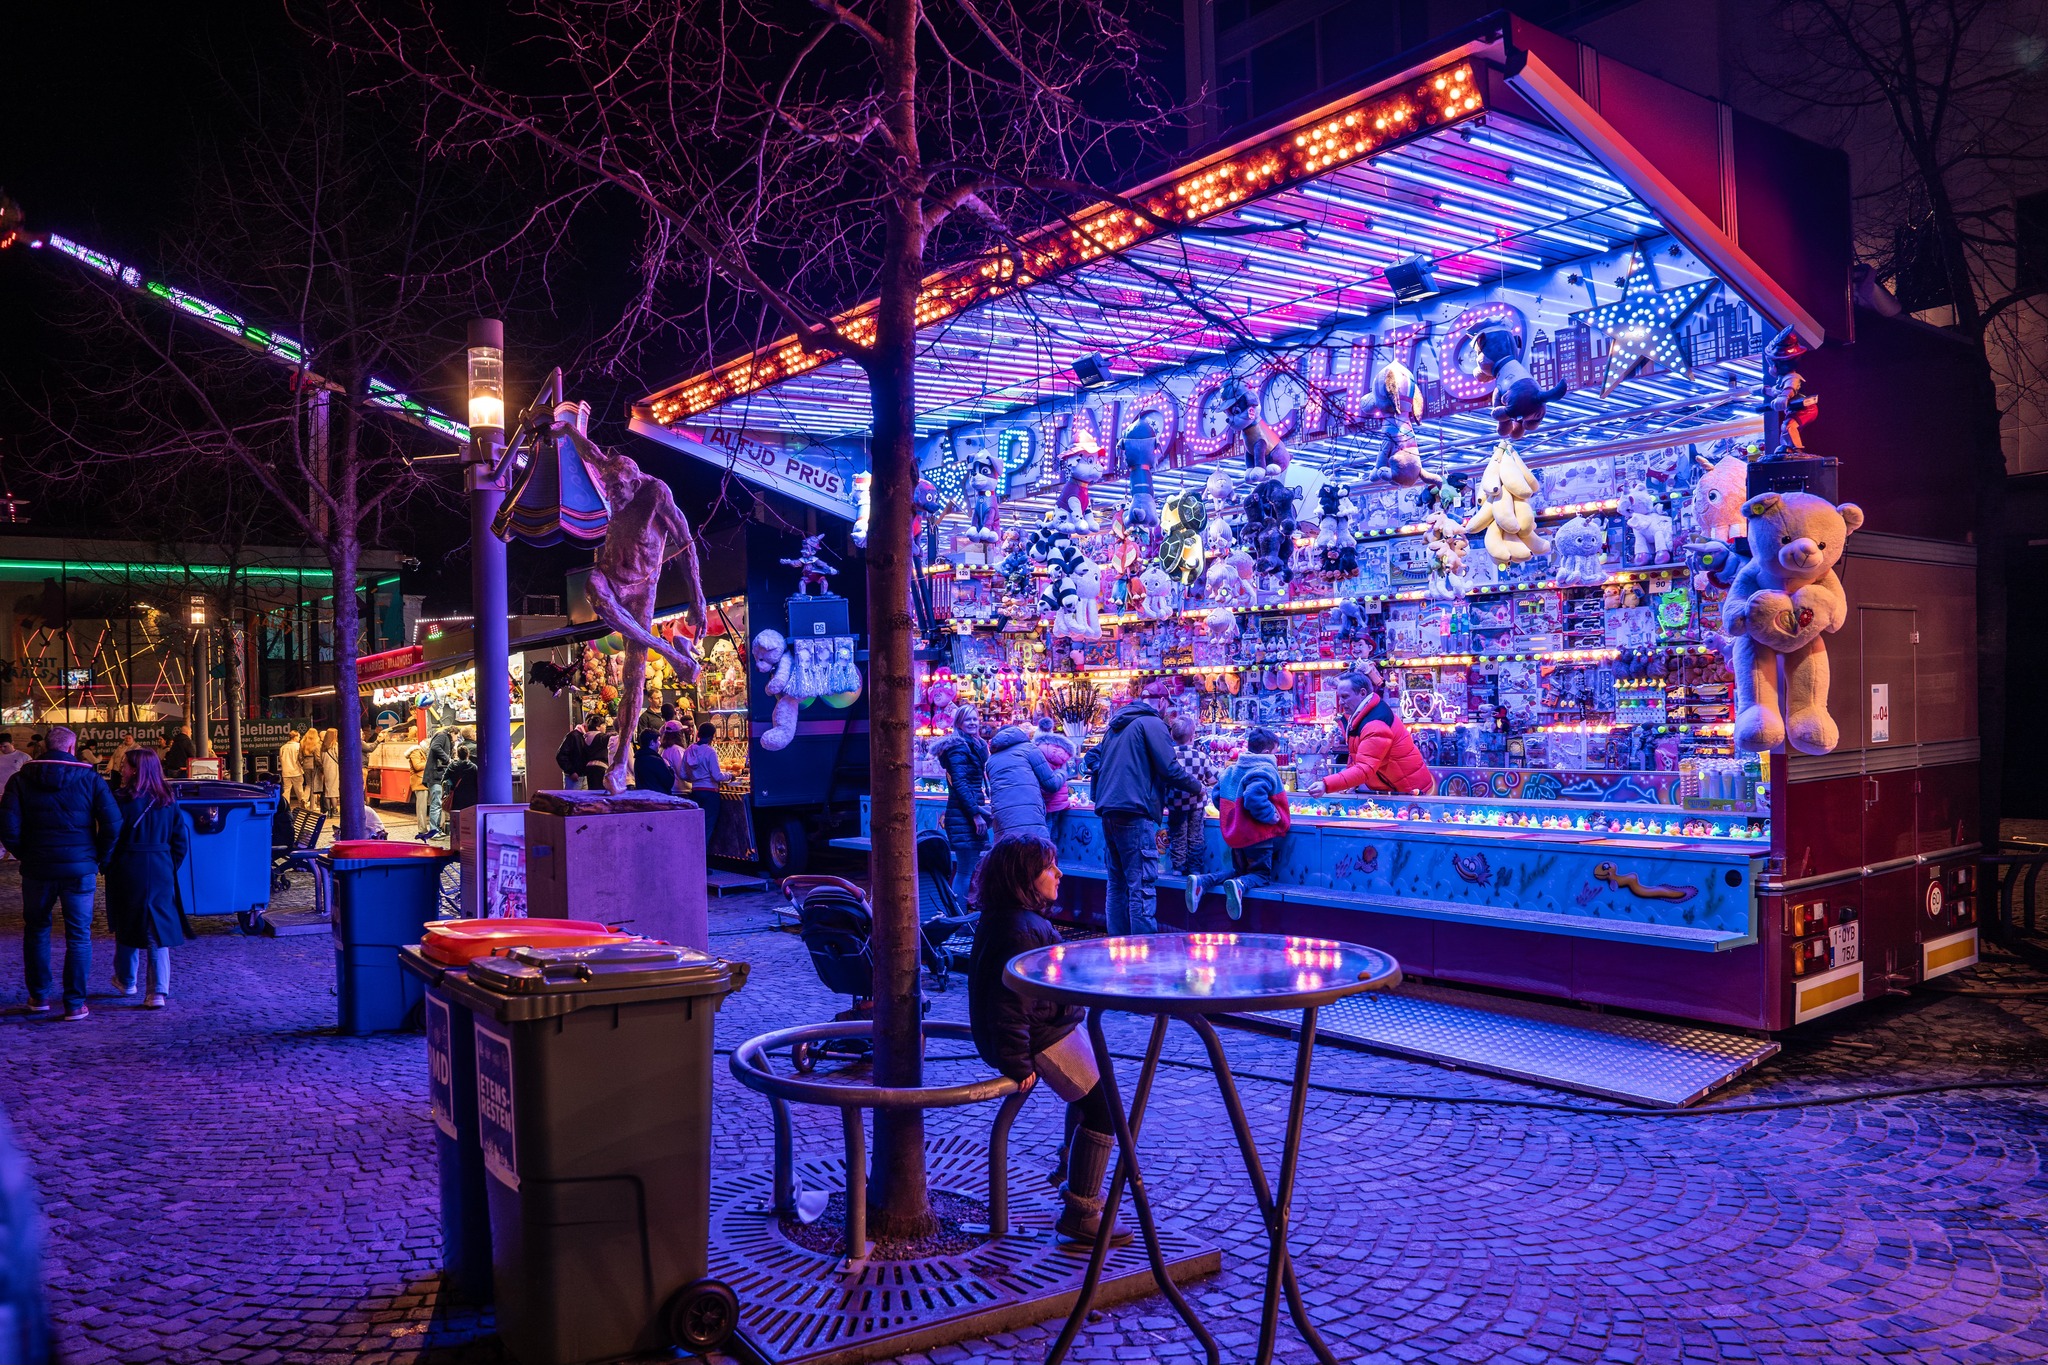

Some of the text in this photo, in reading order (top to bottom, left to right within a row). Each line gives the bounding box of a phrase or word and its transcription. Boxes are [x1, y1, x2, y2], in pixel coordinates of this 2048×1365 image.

[214, 723, 291, 737] Afaleiland
[1932, 891, 1941, 905] 60
[1841, 945, 1855, 961] 752
[480, 1094, 512, 1133] RESTEN
